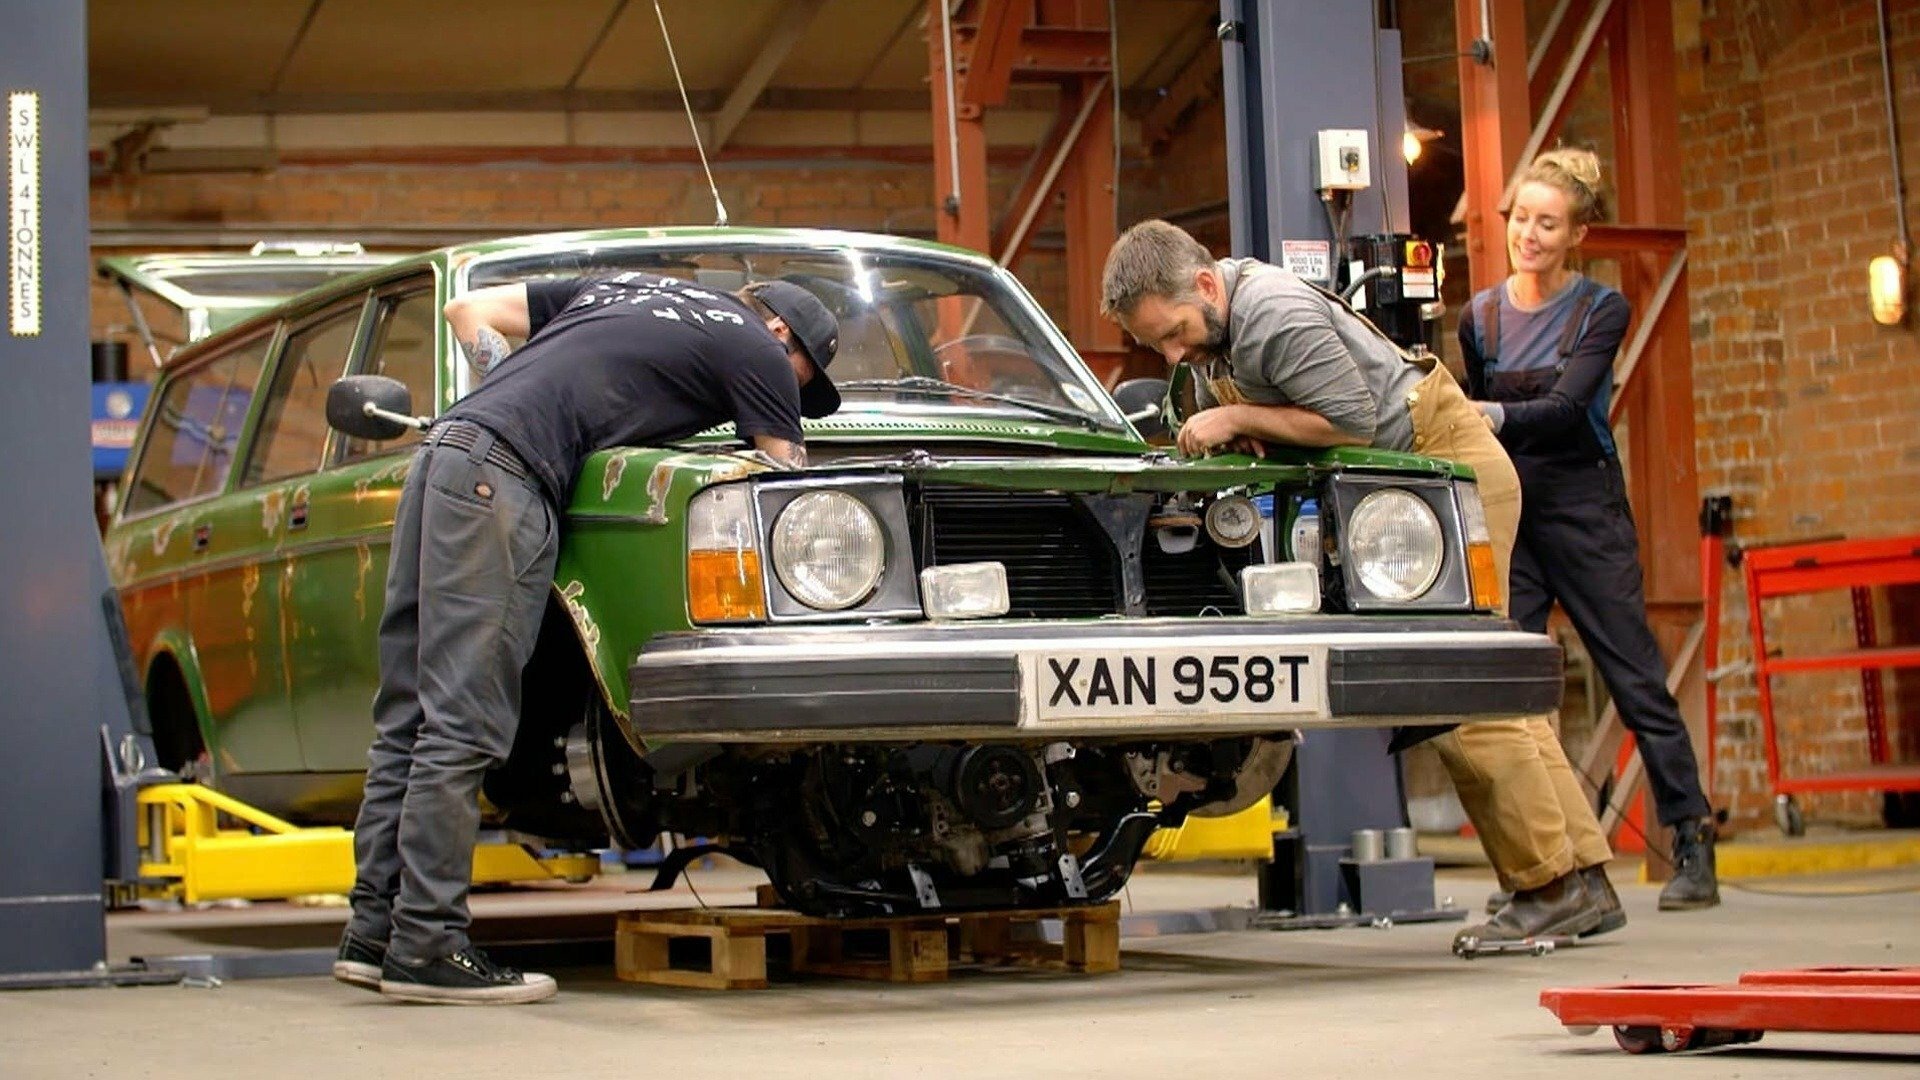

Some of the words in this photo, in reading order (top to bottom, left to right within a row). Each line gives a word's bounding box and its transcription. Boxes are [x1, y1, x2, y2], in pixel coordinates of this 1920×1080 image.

[15, 109, 34, 174] SWL
[19, 184, 30, 199] 4
[16, 208, 33, 318] TONNES
[1048, 656, 1156, 707] XAN
[1172, 655, 1310, 705] 958T
